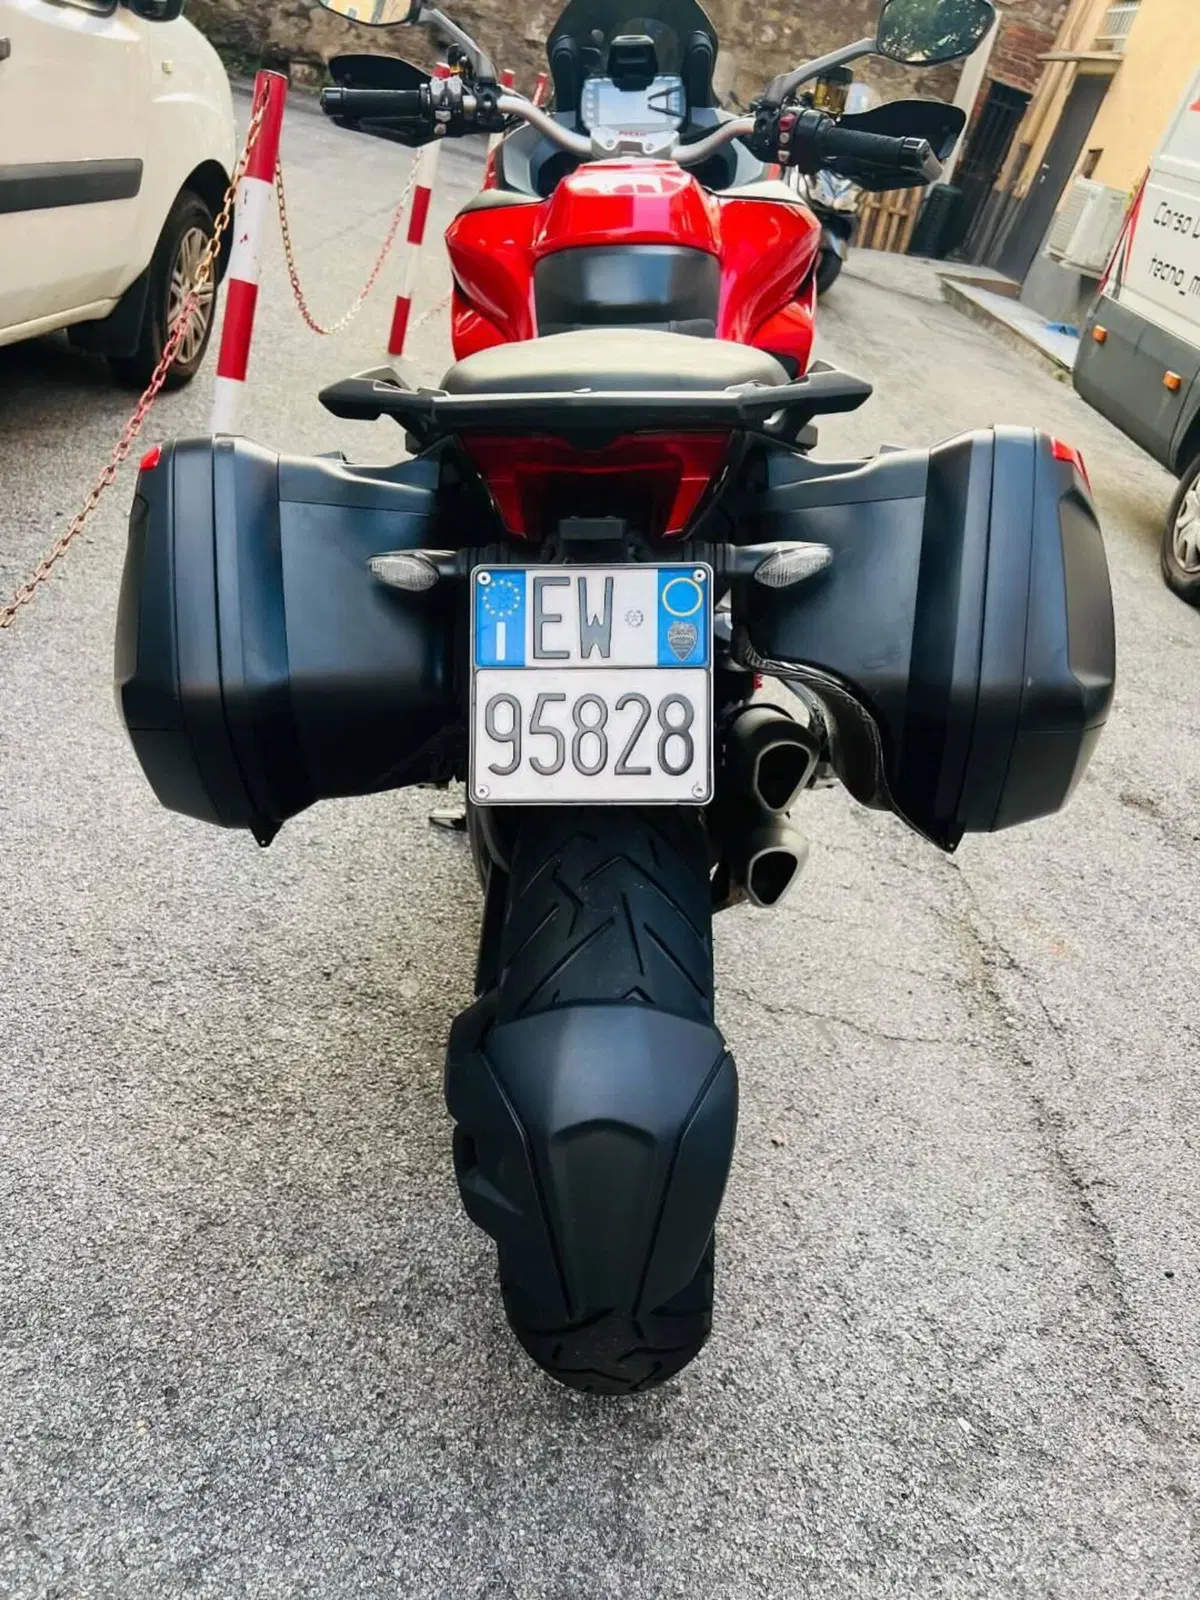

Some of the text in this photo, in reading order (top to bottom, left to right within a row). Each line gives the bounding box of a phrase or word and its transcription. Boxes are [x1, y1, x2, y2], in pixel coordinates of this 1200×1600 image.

[1153, 201, 1192, 234] Corso
[533, 576, 614, 660] EW
[485, 692, 695, 777] 95828
